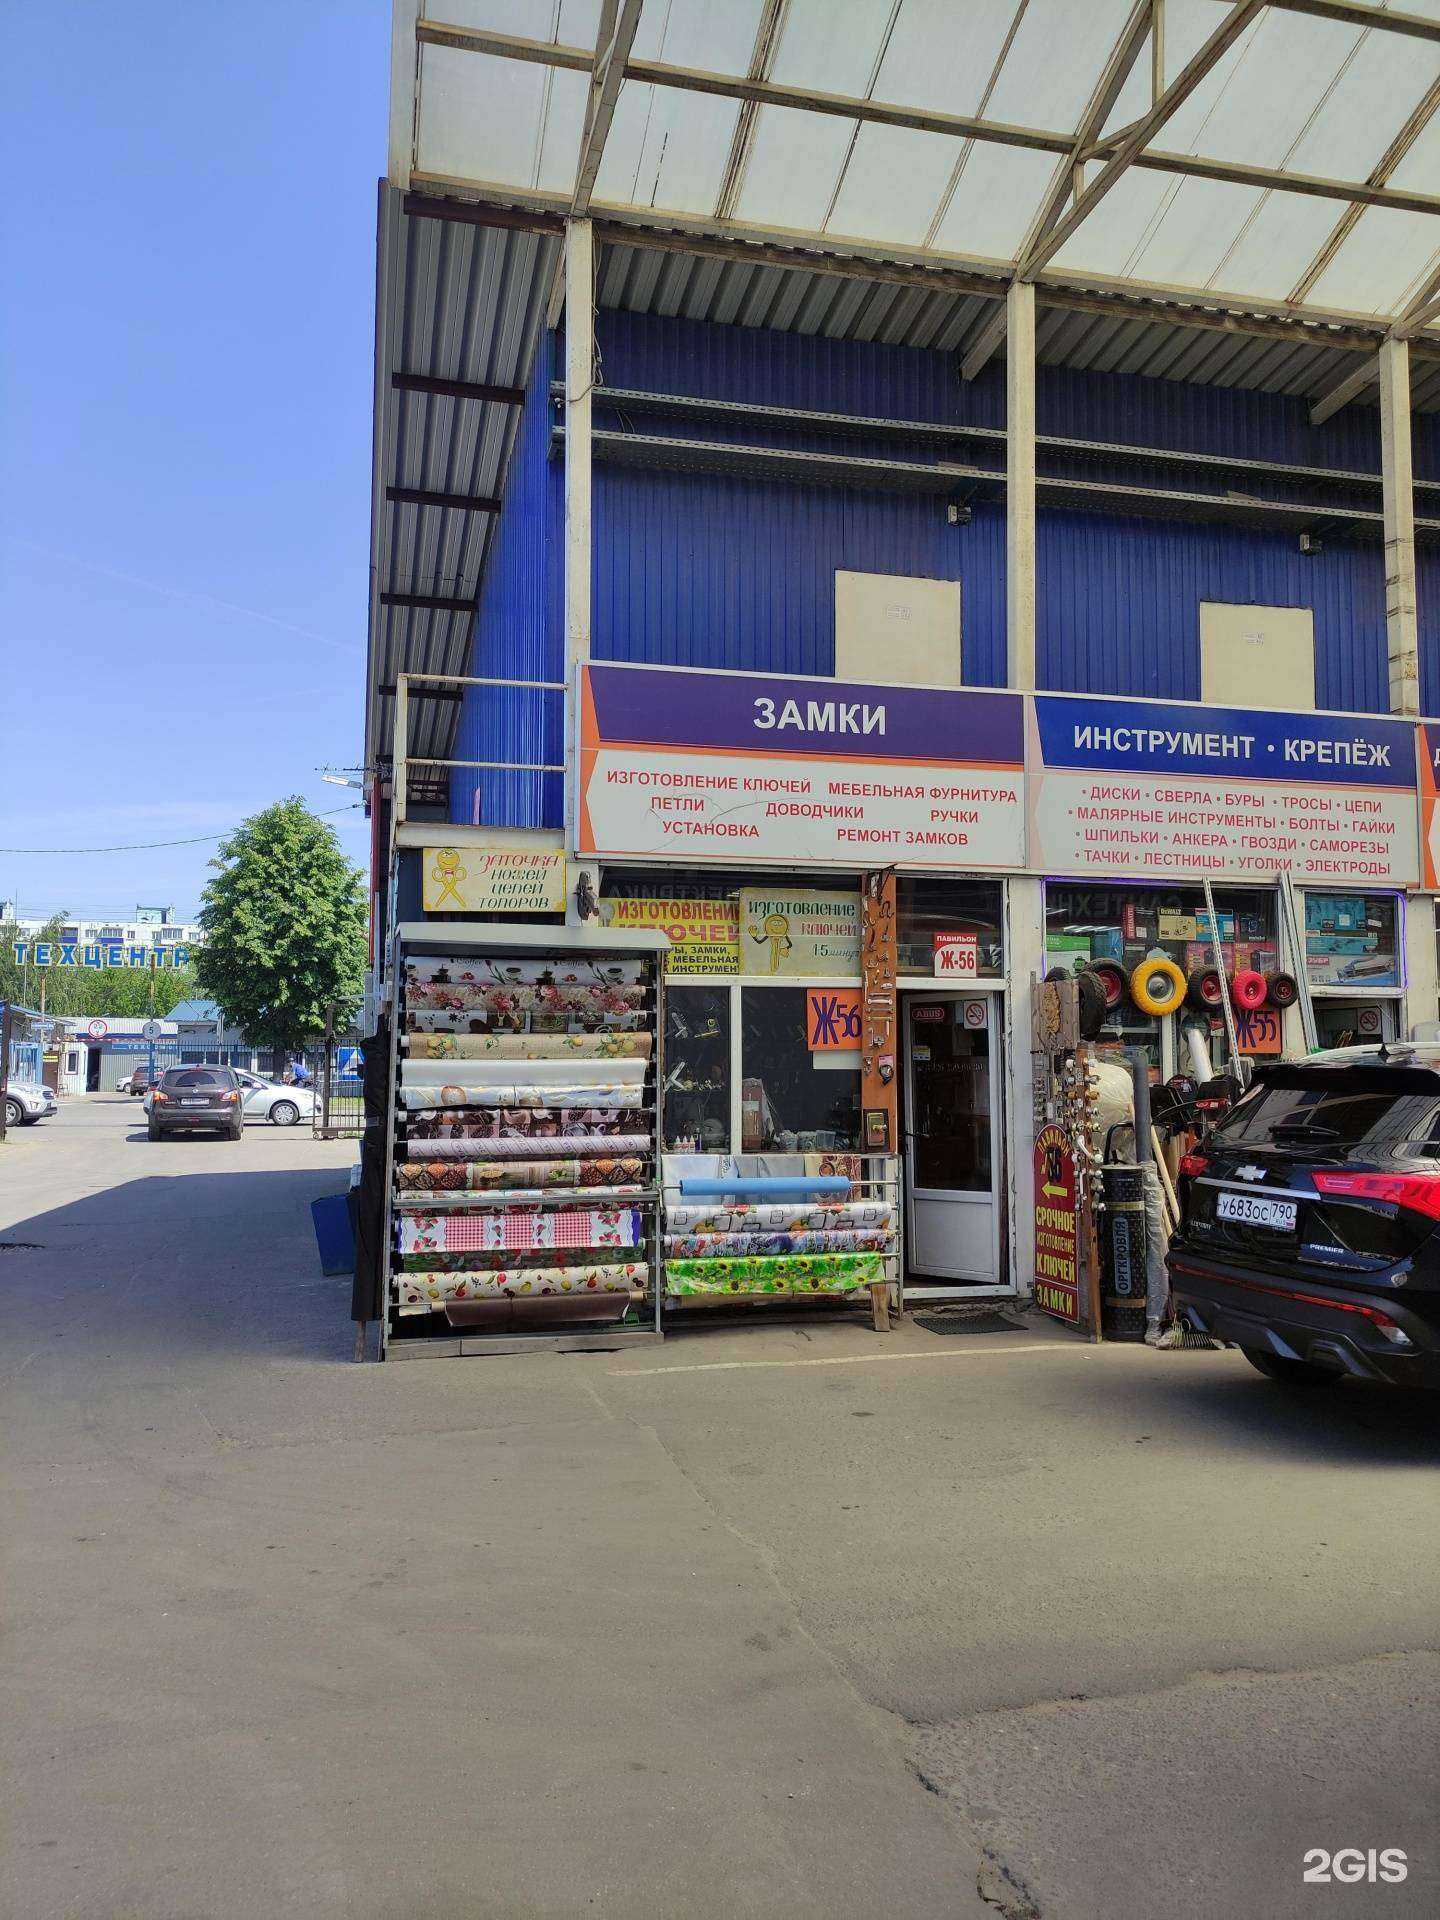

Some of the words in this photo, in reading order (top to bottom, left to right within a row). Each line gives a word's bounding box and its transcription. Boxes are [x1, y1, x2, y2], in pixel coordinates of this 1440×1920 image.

[752, 697, 887, 736] ЗАМКИ
[1073, 725, 1256, 759] ИНСТРУМЕНТ
[1283, 738, 1391, 767] КРЕПЁЖ
[607, 770, 738, 791] ИЗГОТОВЛЕНИЕ
[743, 777, 811, 794] КЛЮЧЕЙ
[828, 782, 925, 799] МЕБЕЛЬНАЯ
[929, 785, 1017, 803] ФУРНИТУРА
[1090, 786, 1141, 802] ДИСКИ
[1154, 789, 1212, 805] СВЕРЛА
[1225, 793, 1265, 808] БУРЫ
[1281, 796, 1332, 811] ТРОСЫ
[1344, 799, 1382, 814] ЦЕПИ
[651, 797, 705, 812] ПЕТЛИ
[766, 802, 864, 820] ДОВОДЧИКИ
[930, 809, 979, 823] РУЧКИ
[1077, 807, 1164, 823] МАЛЯРНЫЕ
[1167, 811, 1276, 829] ИНСТРУМЕНТЫ
[1289, 817, 1340, 832] БОЛТЫ
[1351, 818, 1395, 834] ГАЙКИ
[662, 821, 760, 837] УСТАНОВКА
[836, 828, 901, 844] РЕМОНТ
[905, 830, 968, 846] ЗАМКОВ
[1085, 829, 1159, 845] ШПИЛЬКИ
[1172, 833, 1228, 847] АНКЕРА
[1241, 835, 1297, 852] ГВОЗДИ
[1309, 839, 1389, 854] САМОРЕЗЫ
[1084, 849, 1130, 864] ТАЧКИ
[1143, 852, 1225, 869] ЛЕСТНИЦЫ
[1238, 856, 1292, 871] УГОЛКИ
[1304, 859, 1391, 875] ЭЛЕКТРОДЫ
[13, 943, 191, 969] ТЕХЦЕНТР
[941, 951, 975, 969] Ж-56
[811, 997, 862, 1045] Ж-56
[1036, 1206, 1075, 1233] СРОЧНОЕ
[1273, 1203, 1292, 1219] 790
[1116, 1221, 1129, 1290] ОРГКРОВЛЯ
[1310, 1243, 1344, 1254] PREMIER
[1036, 1252, 1075, 1282] КЛЮЧЕЙ
[1037, 1284, 1073, 1315] ЗАМКИ
